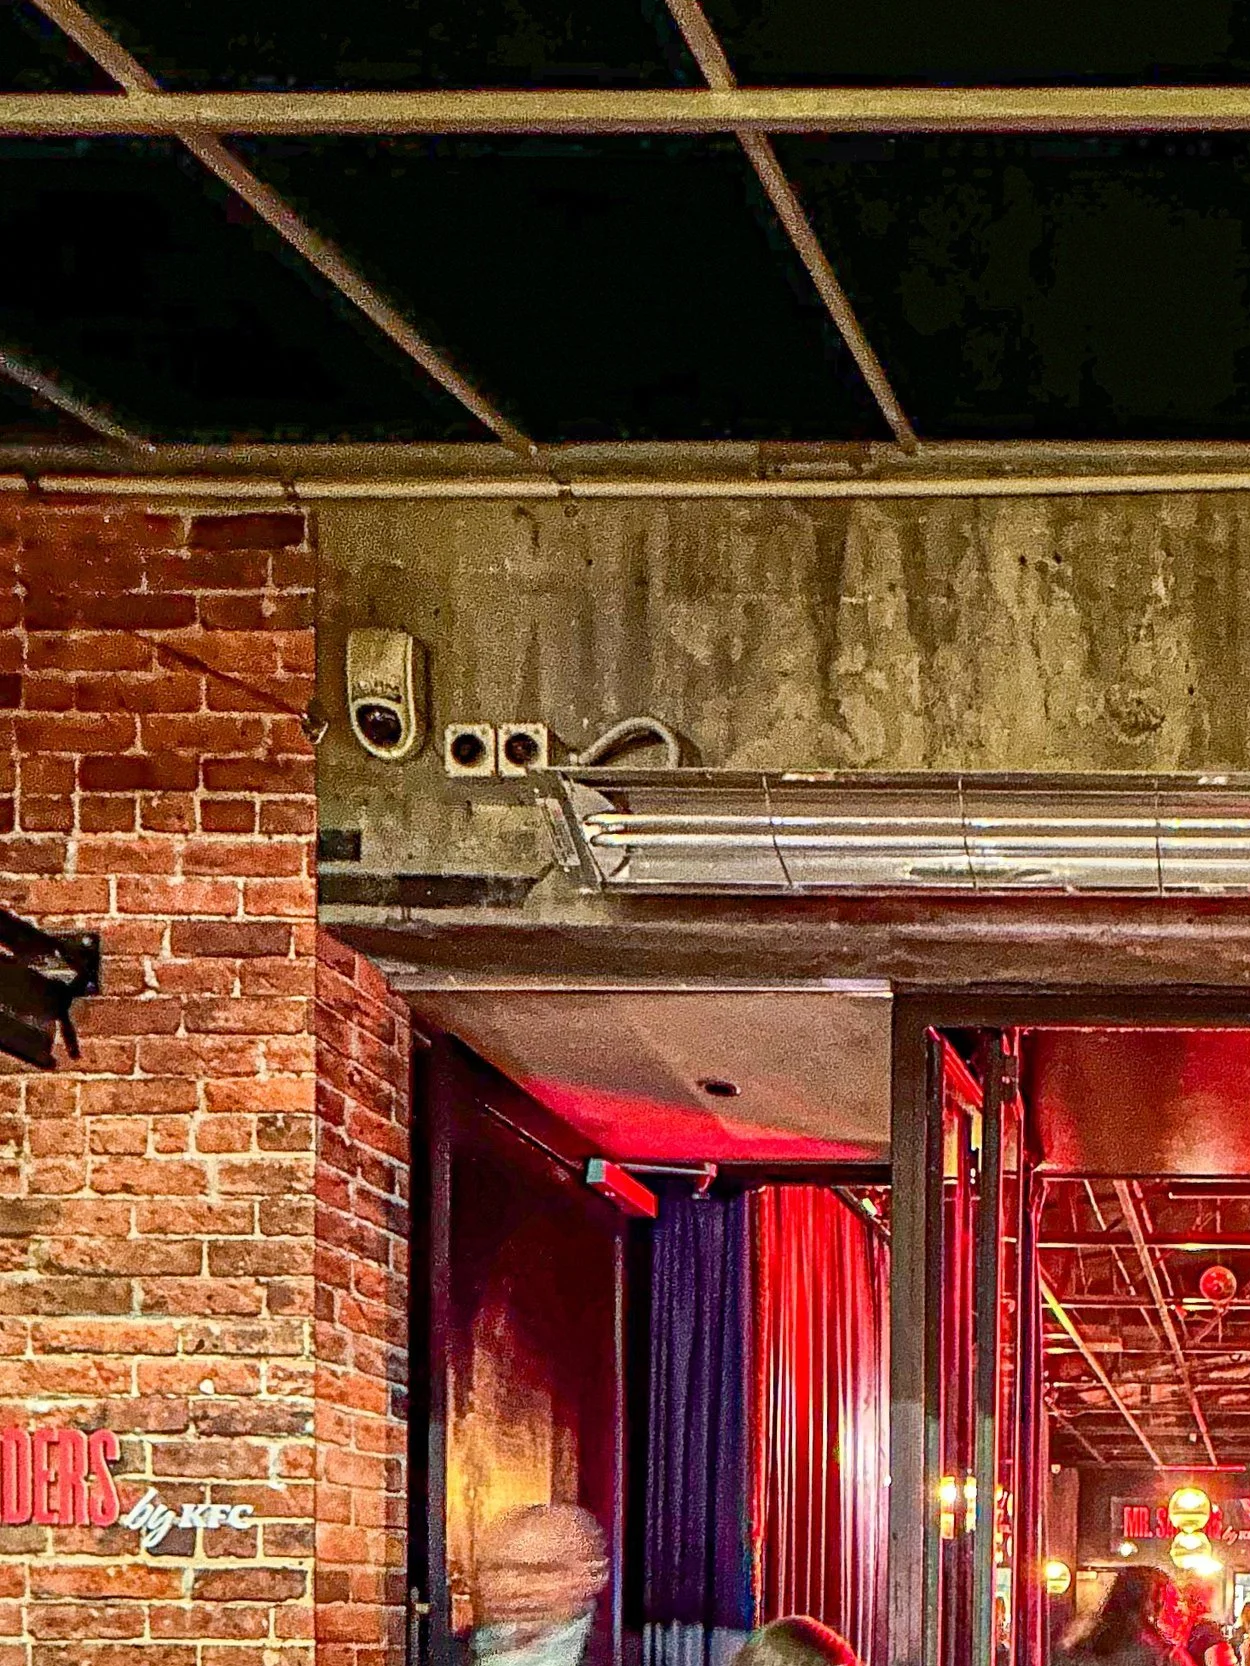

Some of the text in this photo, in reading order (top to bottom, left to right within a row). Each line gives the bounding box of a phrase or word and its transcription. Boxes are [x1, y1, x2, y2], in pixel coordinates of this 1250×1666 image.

[122, 1486, 176, 1548] by
[178, 1503, 254, 1529] KFC
[1123, 1506, 1153, 1538] MR.
